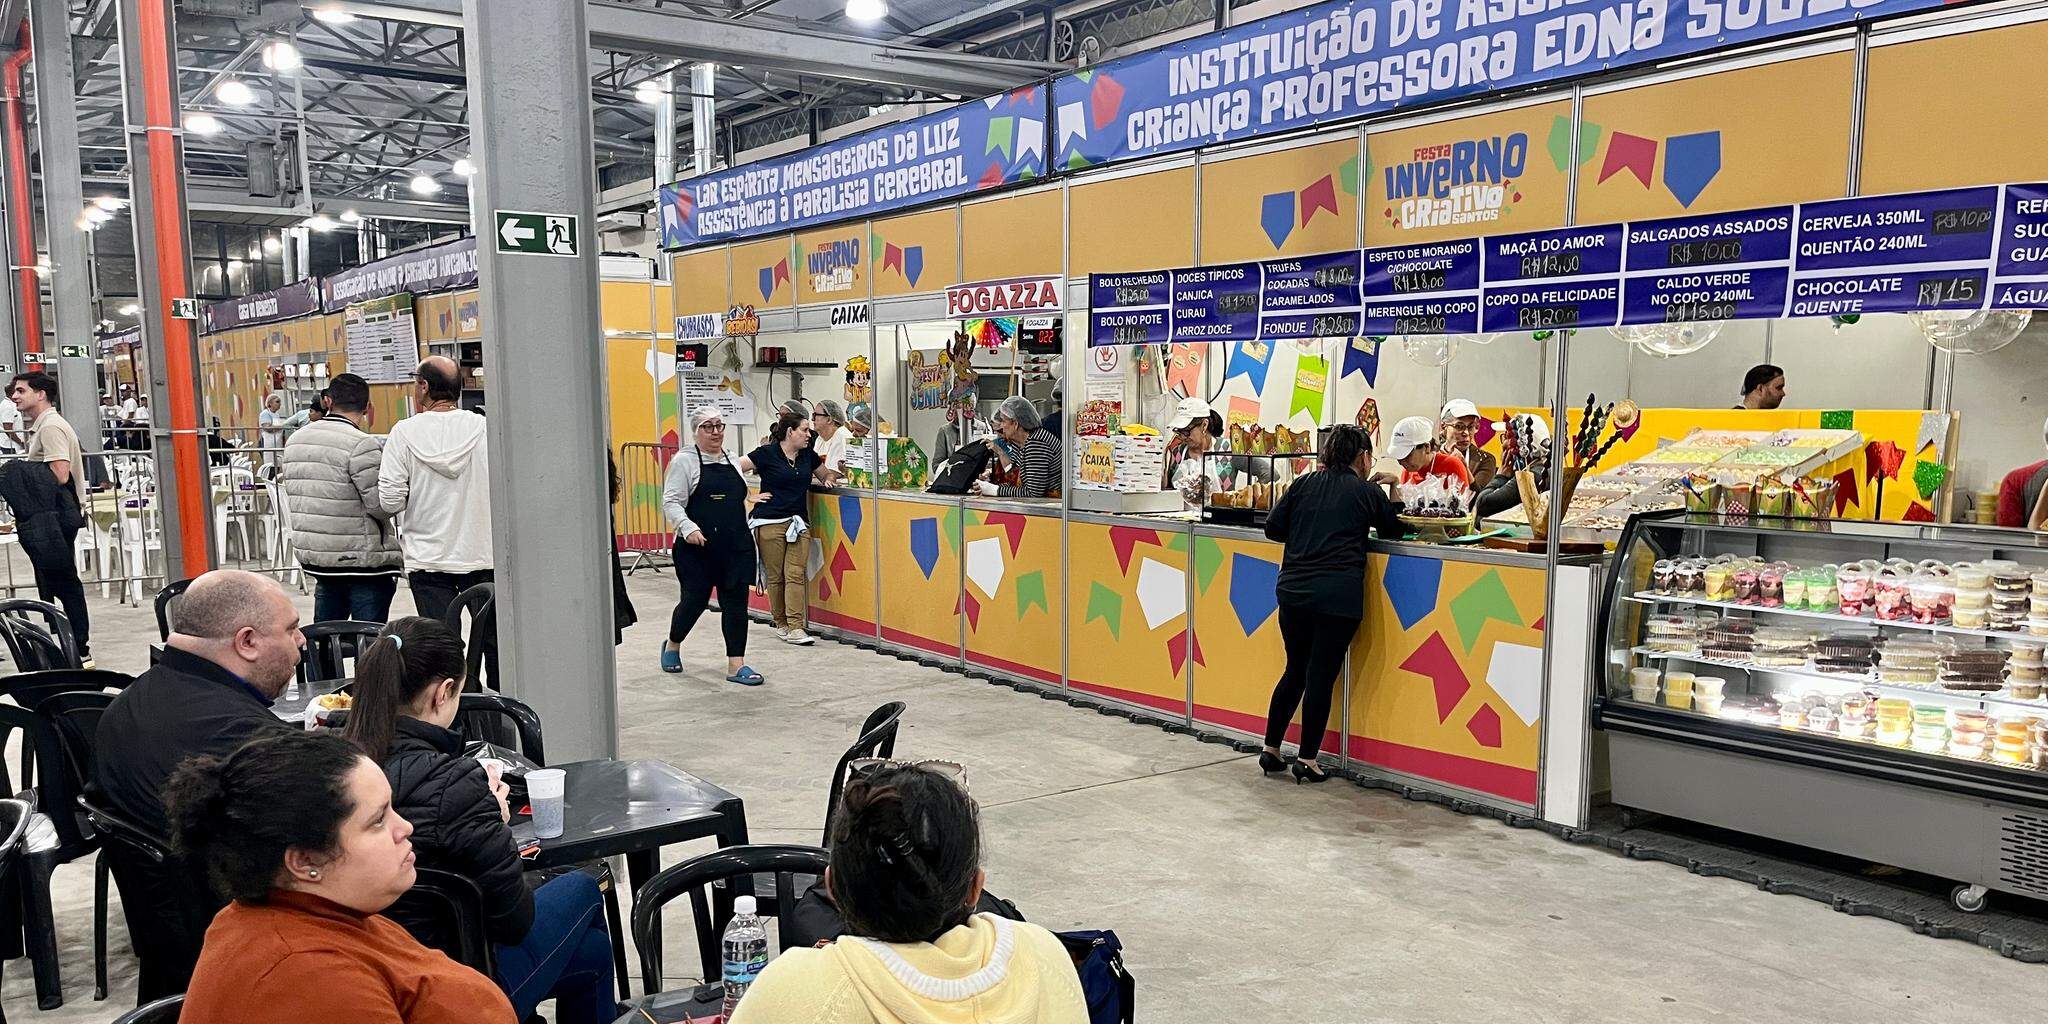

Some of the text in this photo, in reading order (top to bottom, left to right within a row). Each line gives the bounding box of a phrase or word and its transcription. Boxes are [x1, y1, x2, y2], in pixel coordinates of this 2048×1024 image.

[924, 117, 960, 155] LUZ
[1802, 209, 1926, 232] CERVEJA 350ML
[1630, 217, 1788, 244] SALGADOS ASSADOS
[1369, 243, 1472, 263] ESPETO DE MORANGO
[1500, 234, 1605, 257] MAÇÃ DO AMOR
[1801, 234, 1928, 257] QUENTÃO 240ML
[1266, 262, 1302, 274] TRUFAS
[1387, 259, 1453, 275] C/CHOCOLATE
[1099, 274, 1165, 288] BOLO RECHEADO
[1177, 268, 1244, 284] DOCES TÍPICOS
[1267, 278, 1310, 290] COCADAS
[1657, 273, 1751, 290] CALDO VERDE
[1797, 277, 1903, 297] CHOCOLATE
[948, 281, 1059, 314] FOGAZZA
[1176, 290, 1214, 302] CANJICA
[1266, 293, 1334, 308] CARAMELADOS
[1486, 287, 1617, 306] COPO DA FELICIDADE
[1651, 289, 1755, 306] NO COPO 240ML
[831, 304, 868, 325] CAIXA
[1176, 308, 1206, 319] CURAU
[1368, 302, 1476, 318] MERENGUE NO COPO
[1794, 299, 1864, 315] QUENTE
[677, 314, 715, 340] CHURRASCO
[1101, 314, 1162, 327] BOLO NO POTE
[1264, 322, 1307, 335] FONDUE
[1039, 330, 1054, 343] 022
[1176, 324, 1232, 337] ARROZ DOCE
[1085, 454, 1111, 467] CAIXA
